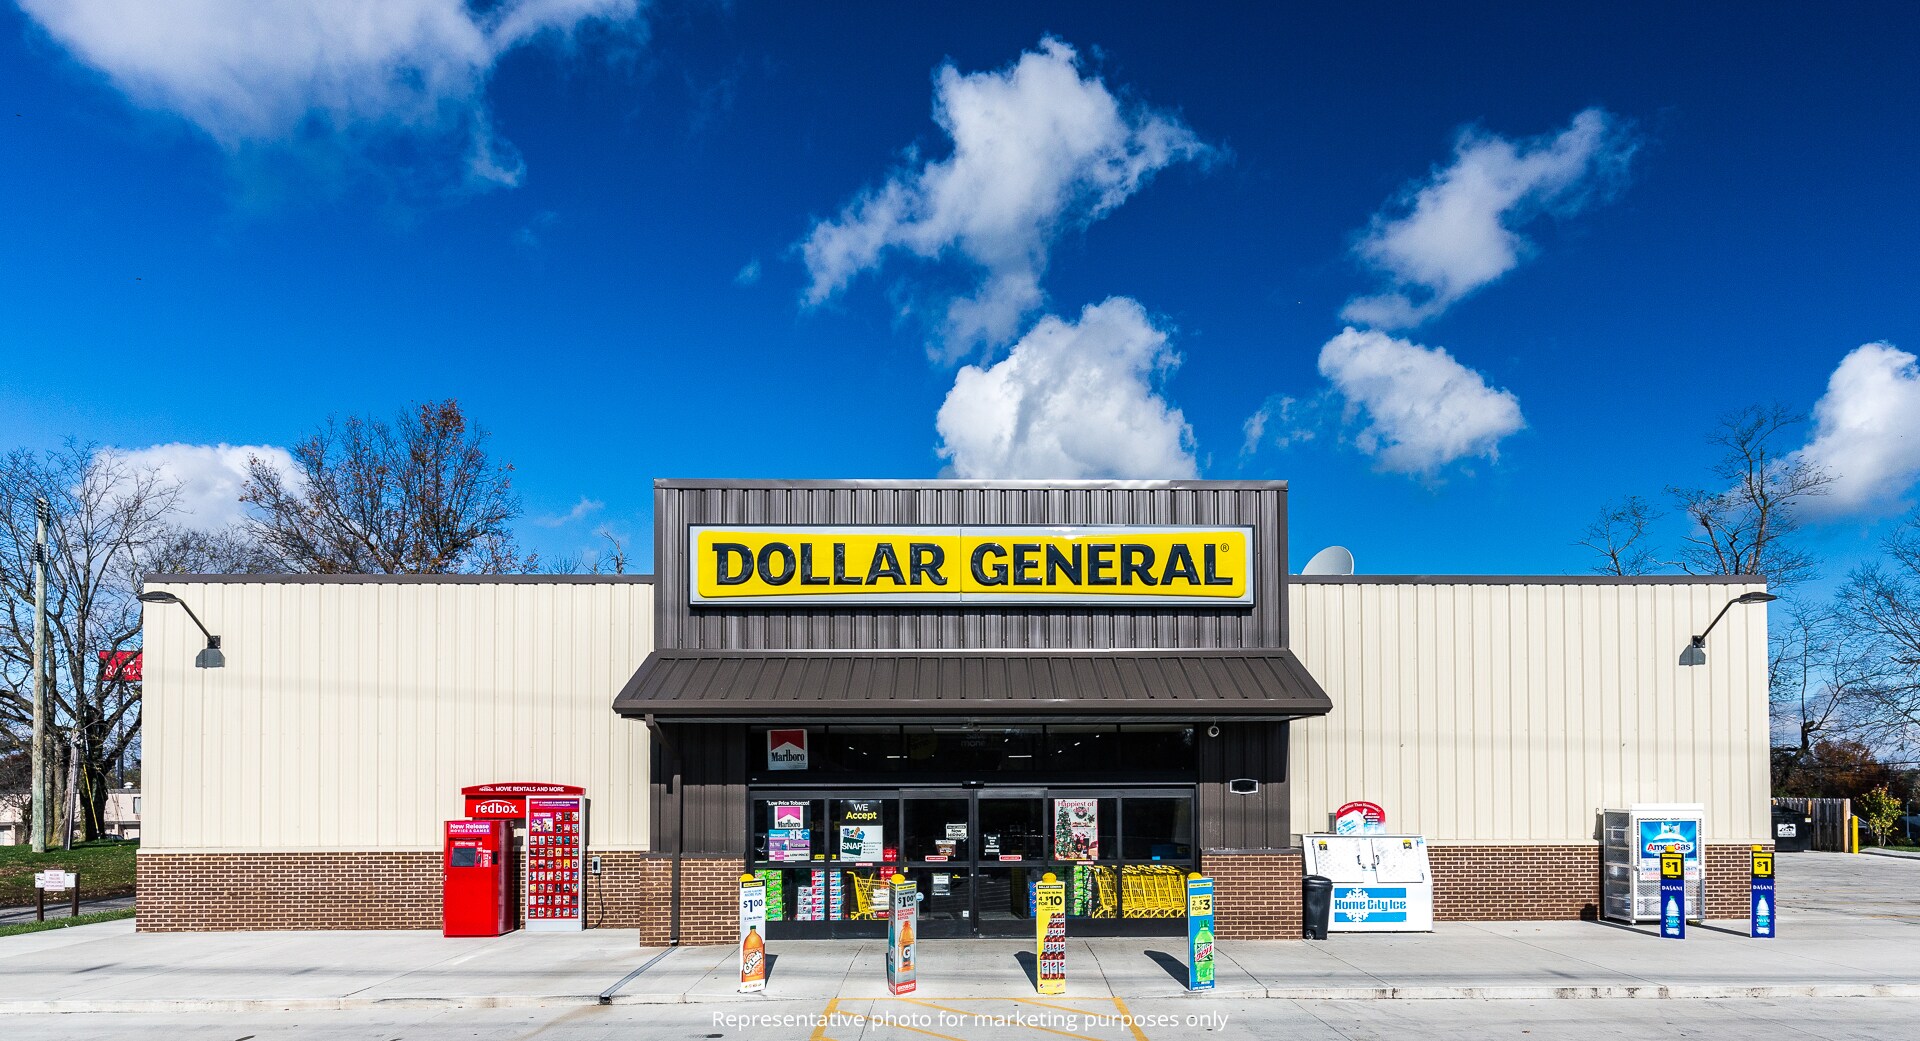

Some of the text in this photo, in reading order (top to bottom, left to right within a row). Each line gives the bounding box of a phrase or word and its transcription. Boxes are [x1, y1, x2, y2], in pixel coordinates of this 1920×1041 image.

[712, 542, 1233, 586] DOLLAR GENERAL
[771, 749, 805, 762] Marlboro
[846, 811, 877, 820] Accept
[778, 819, 801, 828] Marlboro
[842, 842, 863, 850] SNAP
[1666, 861, 1679, 873] $1
[1757, 861, 1769, 872] $1
[1335, 900, 1407, 911] Home City Ice
